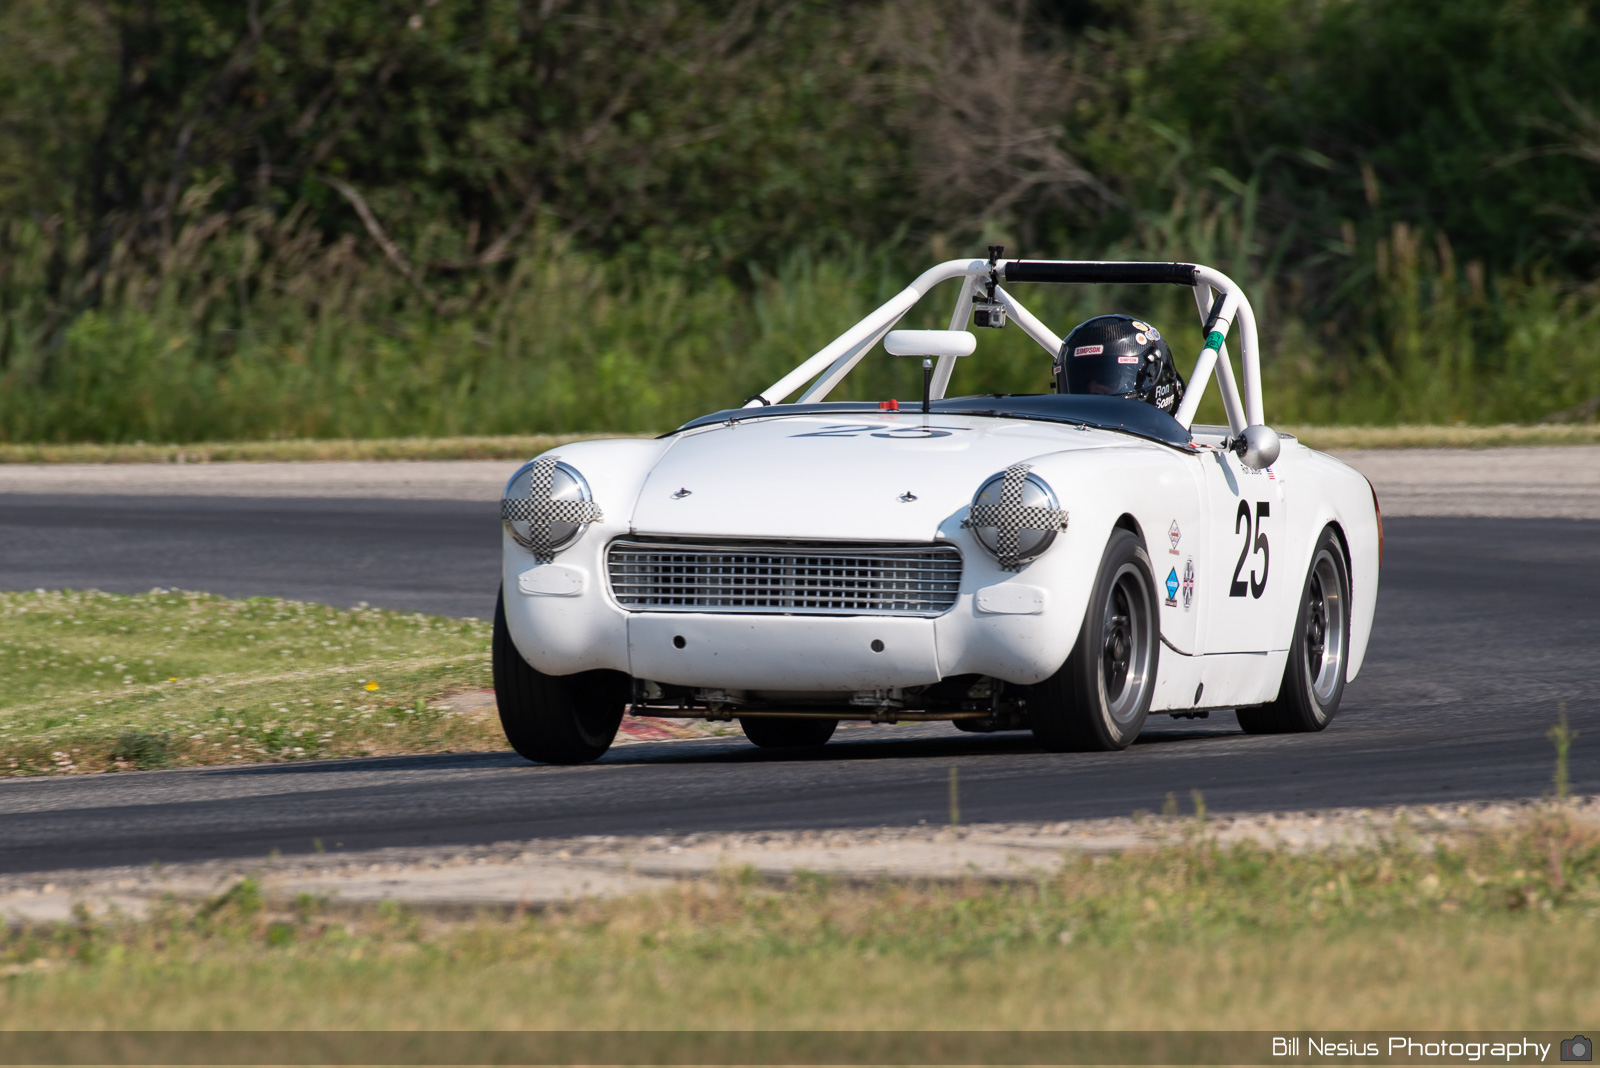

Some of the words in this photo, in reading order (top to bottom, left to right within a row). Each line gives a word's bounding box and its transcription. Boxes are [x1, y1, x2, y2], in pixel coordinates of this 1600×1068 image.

[1075, 346, 1102, 355] SIMPSON
[1155, 384, 1170, 399] Ron
[787, 424, 974, 439] 25
[1229, 499, 1270, 599] 25
